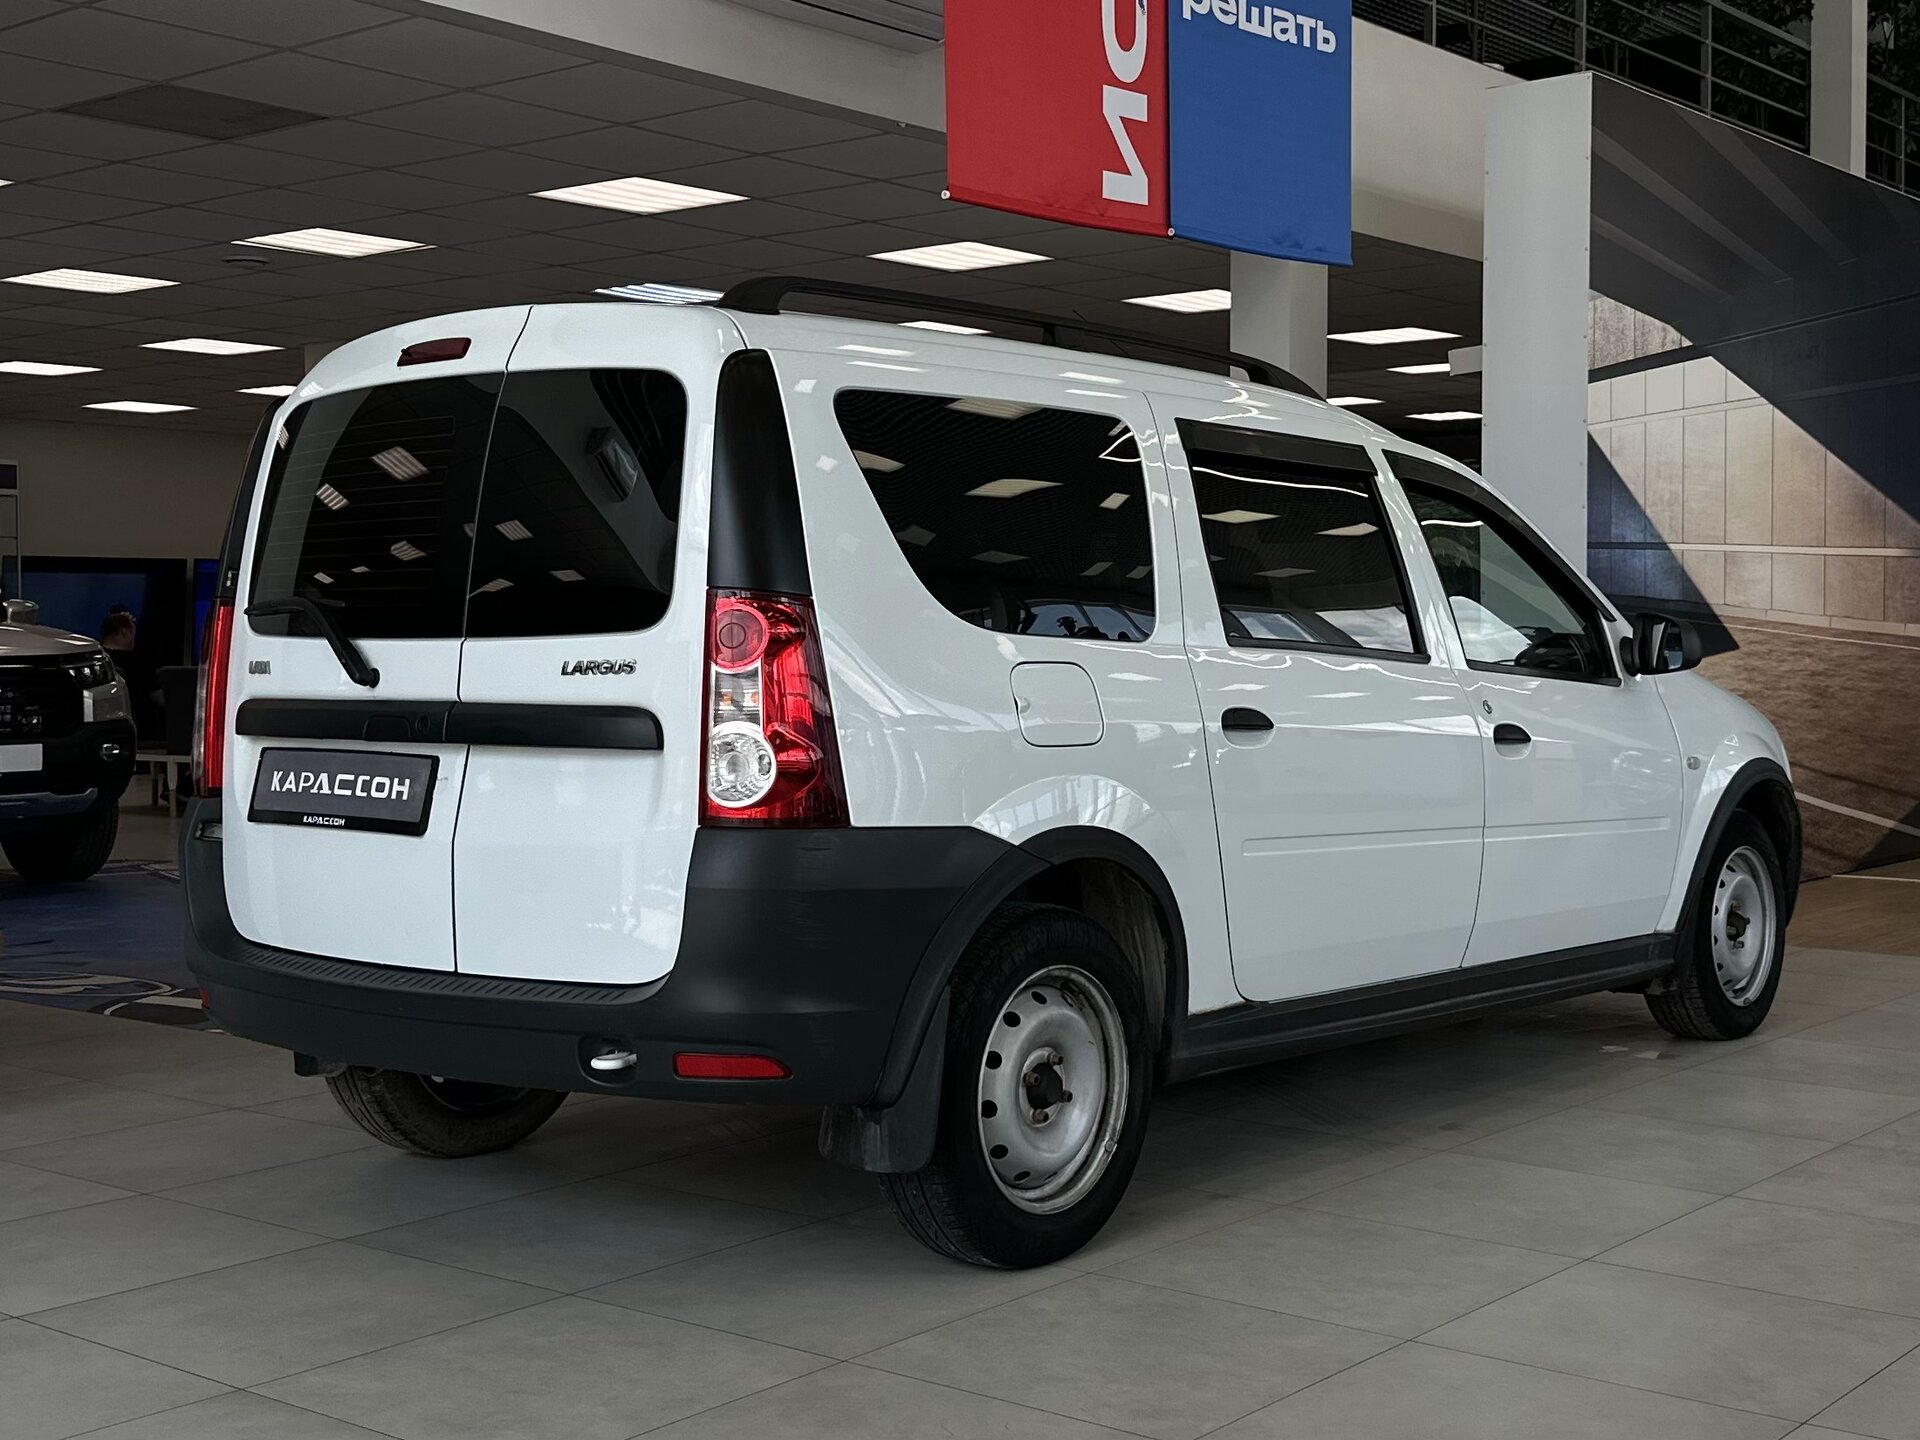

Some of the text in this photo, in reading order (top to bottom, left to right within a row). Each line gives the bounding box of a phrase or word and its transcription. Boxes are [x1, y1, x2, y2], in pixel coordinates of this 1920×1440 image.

[1182, 0, 1336, 53] решать
[561, 659, 637, 676] LARGUS
[271, 771, 410, 800] КАРАССОН
